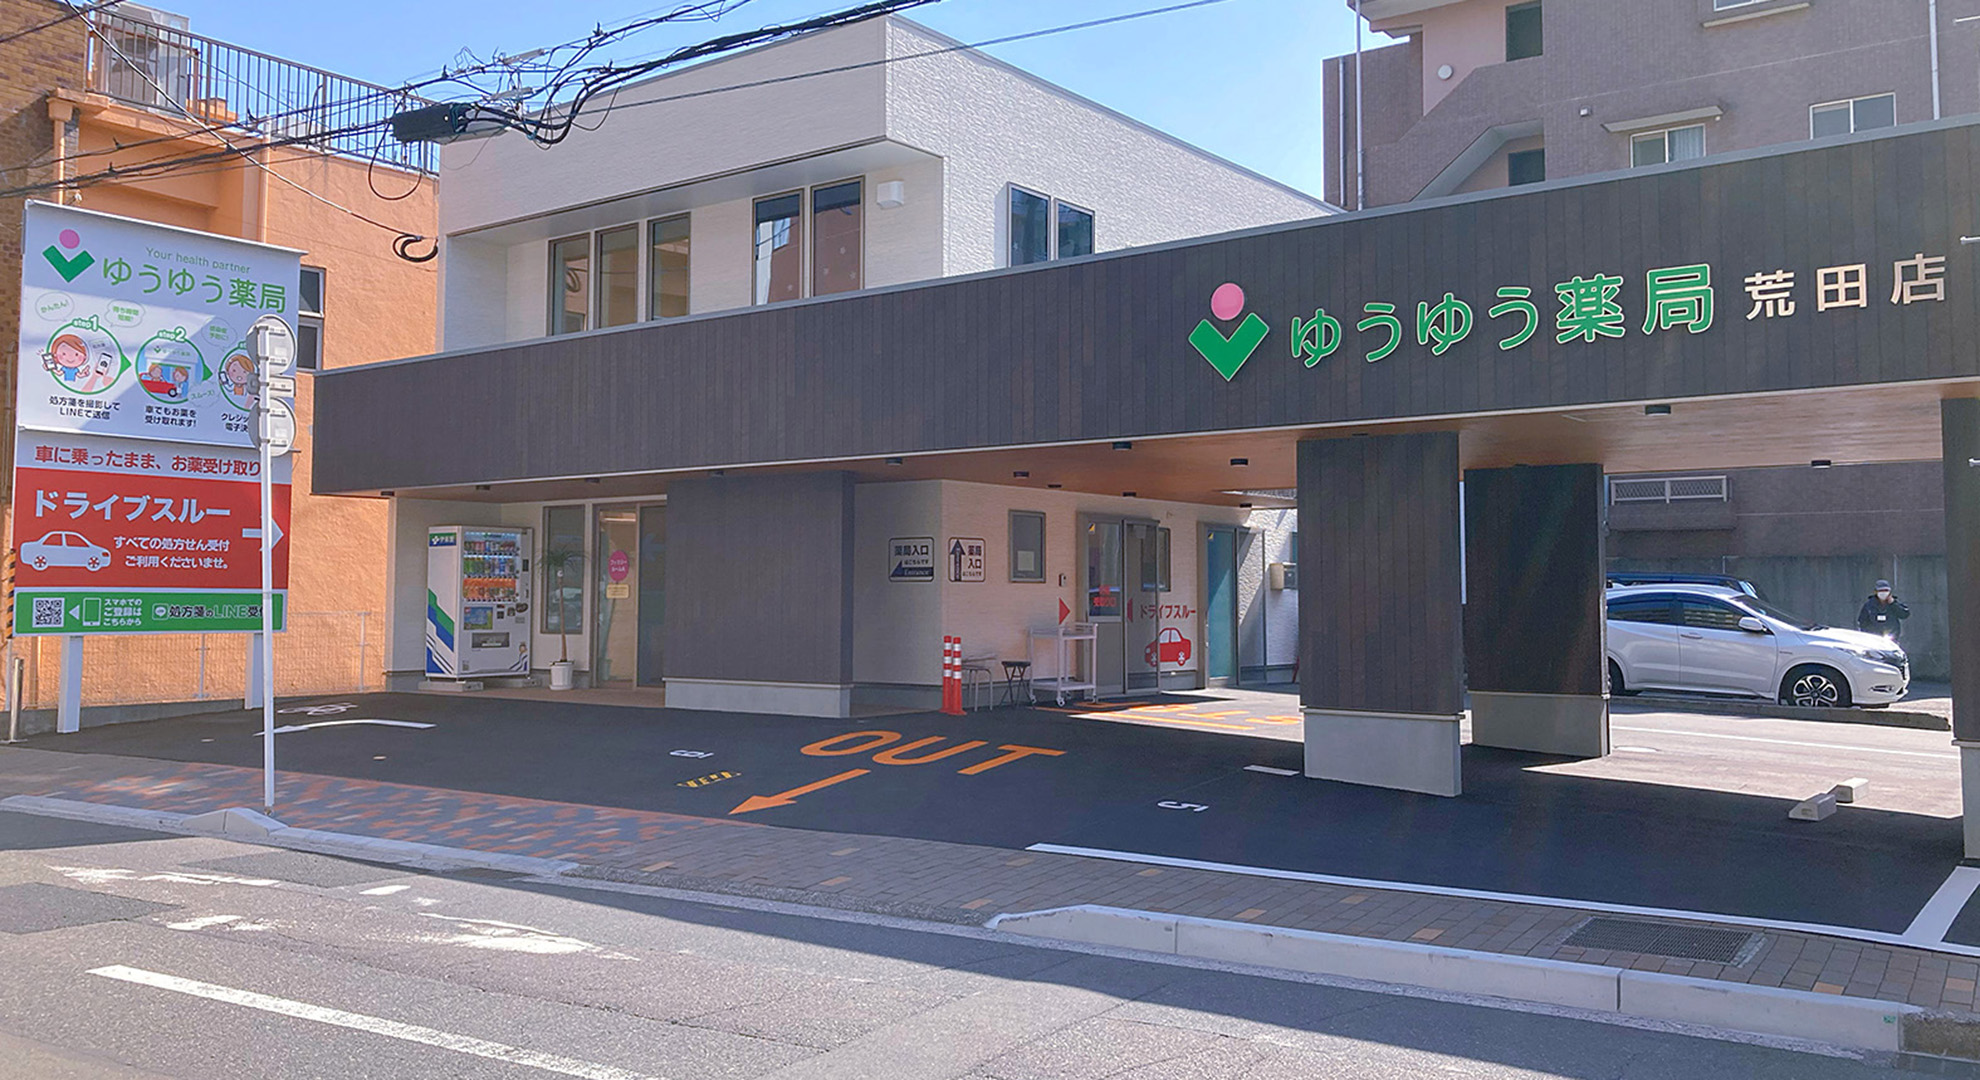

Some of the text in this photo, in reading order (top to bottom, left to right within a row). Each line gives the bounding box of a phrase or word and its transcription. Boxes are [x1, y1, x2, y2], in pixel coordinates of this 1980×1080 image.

[146, 247, 252, 275] Your health partner
[103, 257, 286, 314] ゆうゆう薬局
[1290, 253, 1946, 369] ゆうゆう薬局 荒田店
[59, 407, 110, 420] LINEで送信
[35, 489, 231, 523] ドライブスルー
[113, 536, 230, 552] すべての処方せん受付
[125, 554, 228, 569] ご利用くださいませ。
[968, 558, 982, 569] 入口
[104, 598, 142, 606] スマホでの
[1141, 604, 1197, 619] ドライブスルー
[103, 618, 142, 627] こちらから
[800, 730, 1067, 775] OUT
